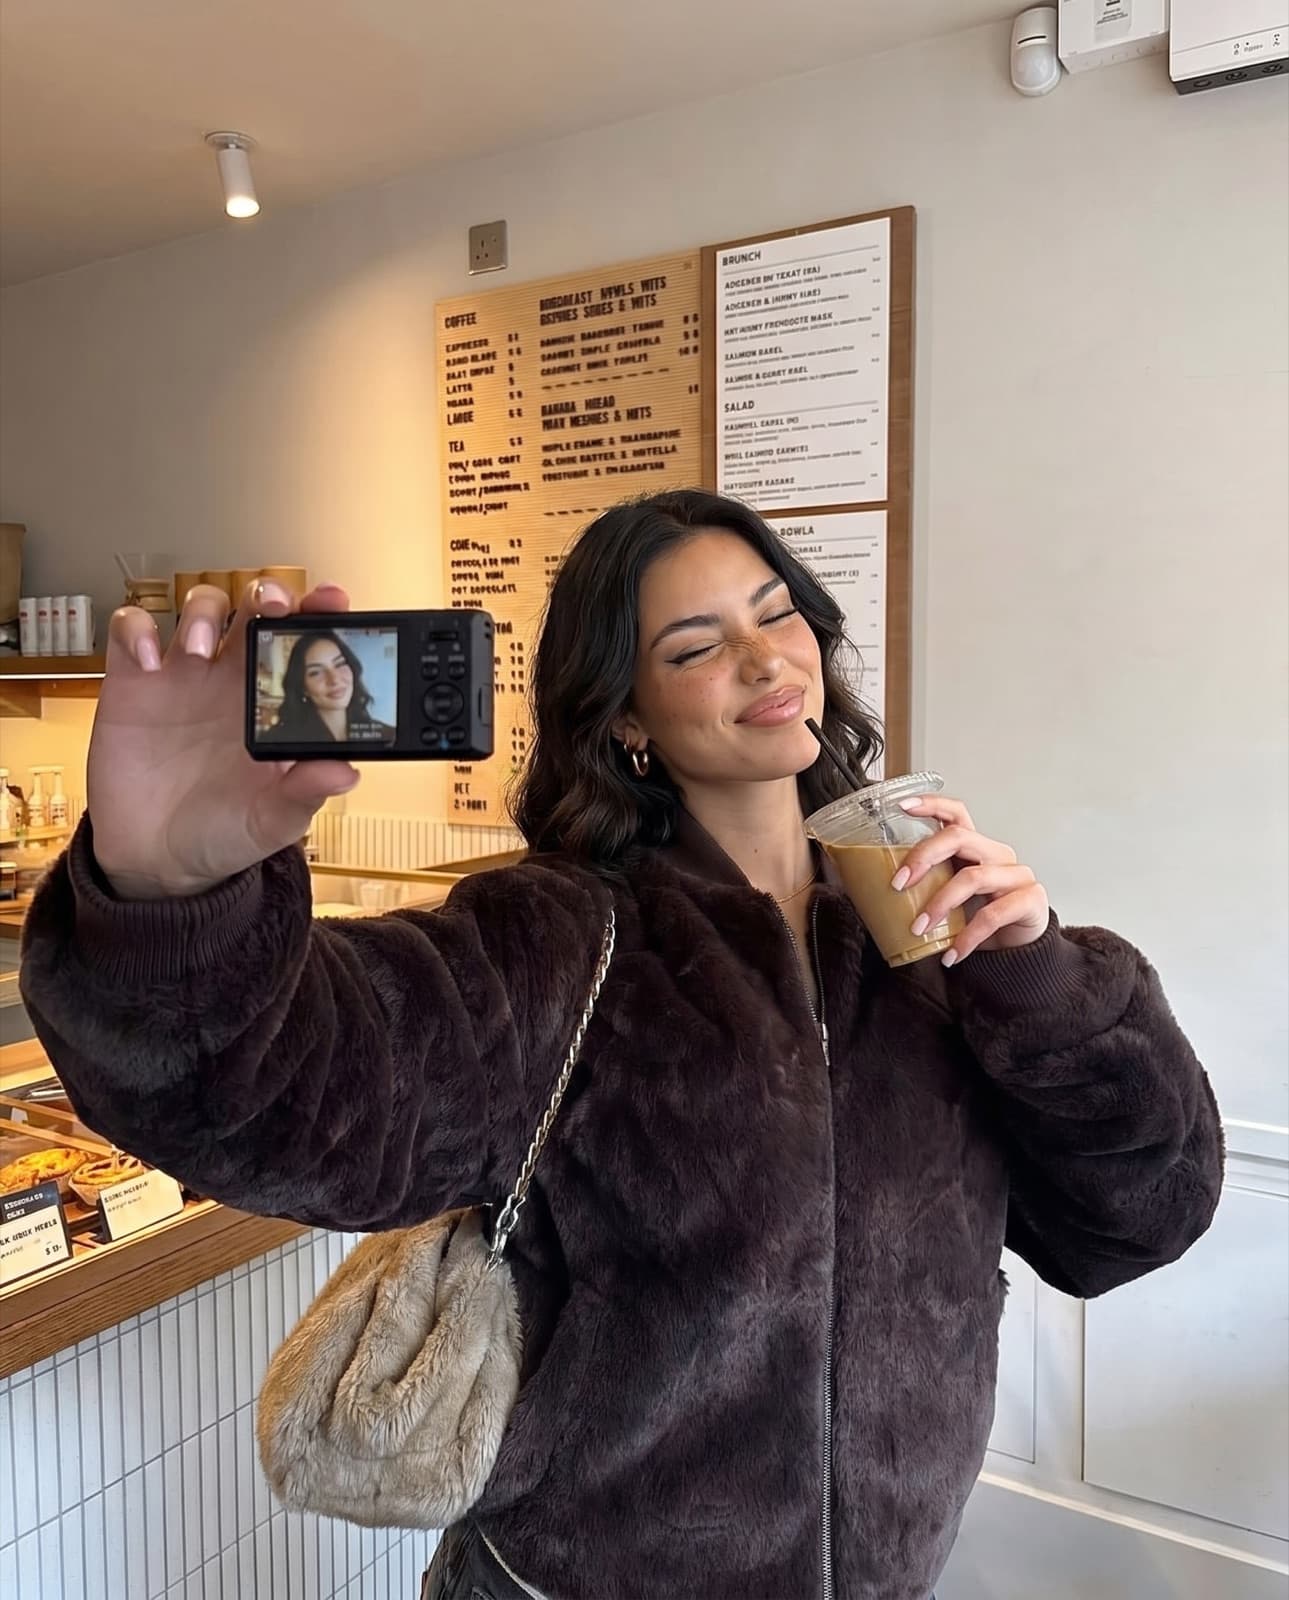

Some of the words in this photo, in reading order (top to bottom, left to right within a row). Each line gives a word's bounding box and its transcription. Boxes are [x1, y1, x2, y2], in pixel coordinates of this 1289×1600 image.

[722, 250, 761, 267] BRUNCH
[445, 312, 477, 329] COFFEE
[724, 400, 755, 413] SALAD
[448, 440, 465, 453] TEA
